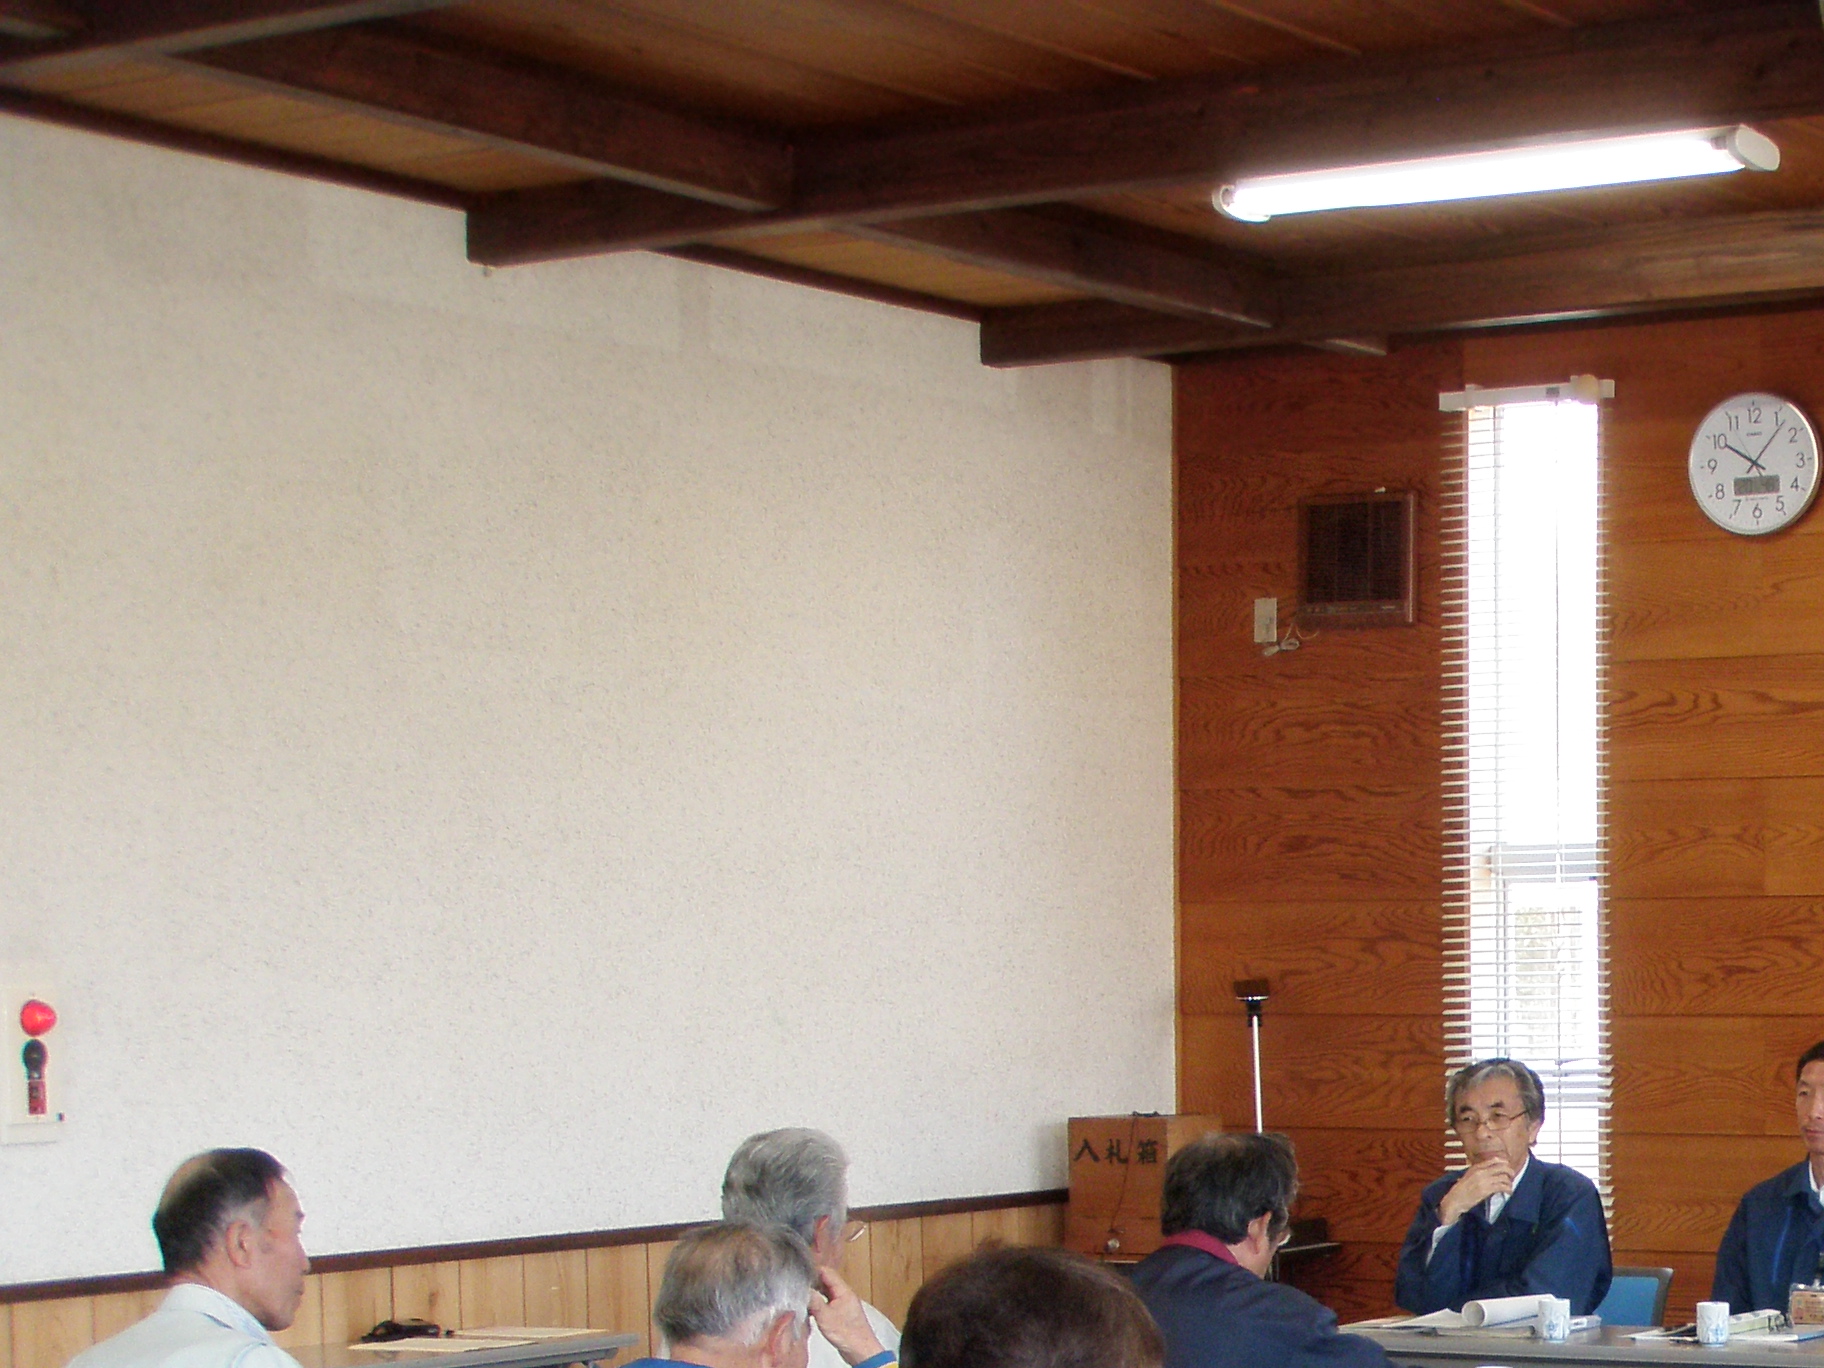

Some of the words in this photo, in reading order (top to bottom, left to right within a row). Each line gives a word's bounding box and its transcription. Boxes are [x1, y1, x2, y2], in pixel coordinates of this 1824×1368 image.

[1728, 415, 1740, 431] 11
[1747, 407, 1762, 424] 12
[1774, 411, 1780, 426] 1
[1712, 433, 1728, 450] 10
[1788, 427, 1798, 443] 2
[1707, 459, 1717, 475] 9
[1796, 452, 1805, 468] 3
[1715, 483, 1725, 500] 8
[1790, 476, 1799, 491] 4
[1732, 499, 1742, 516] 7
[1752, 503, 1763, 519] 6
[1775, 495, 1785, 511] 5
[1073, 1138, 1158, 1165] 入札箱
